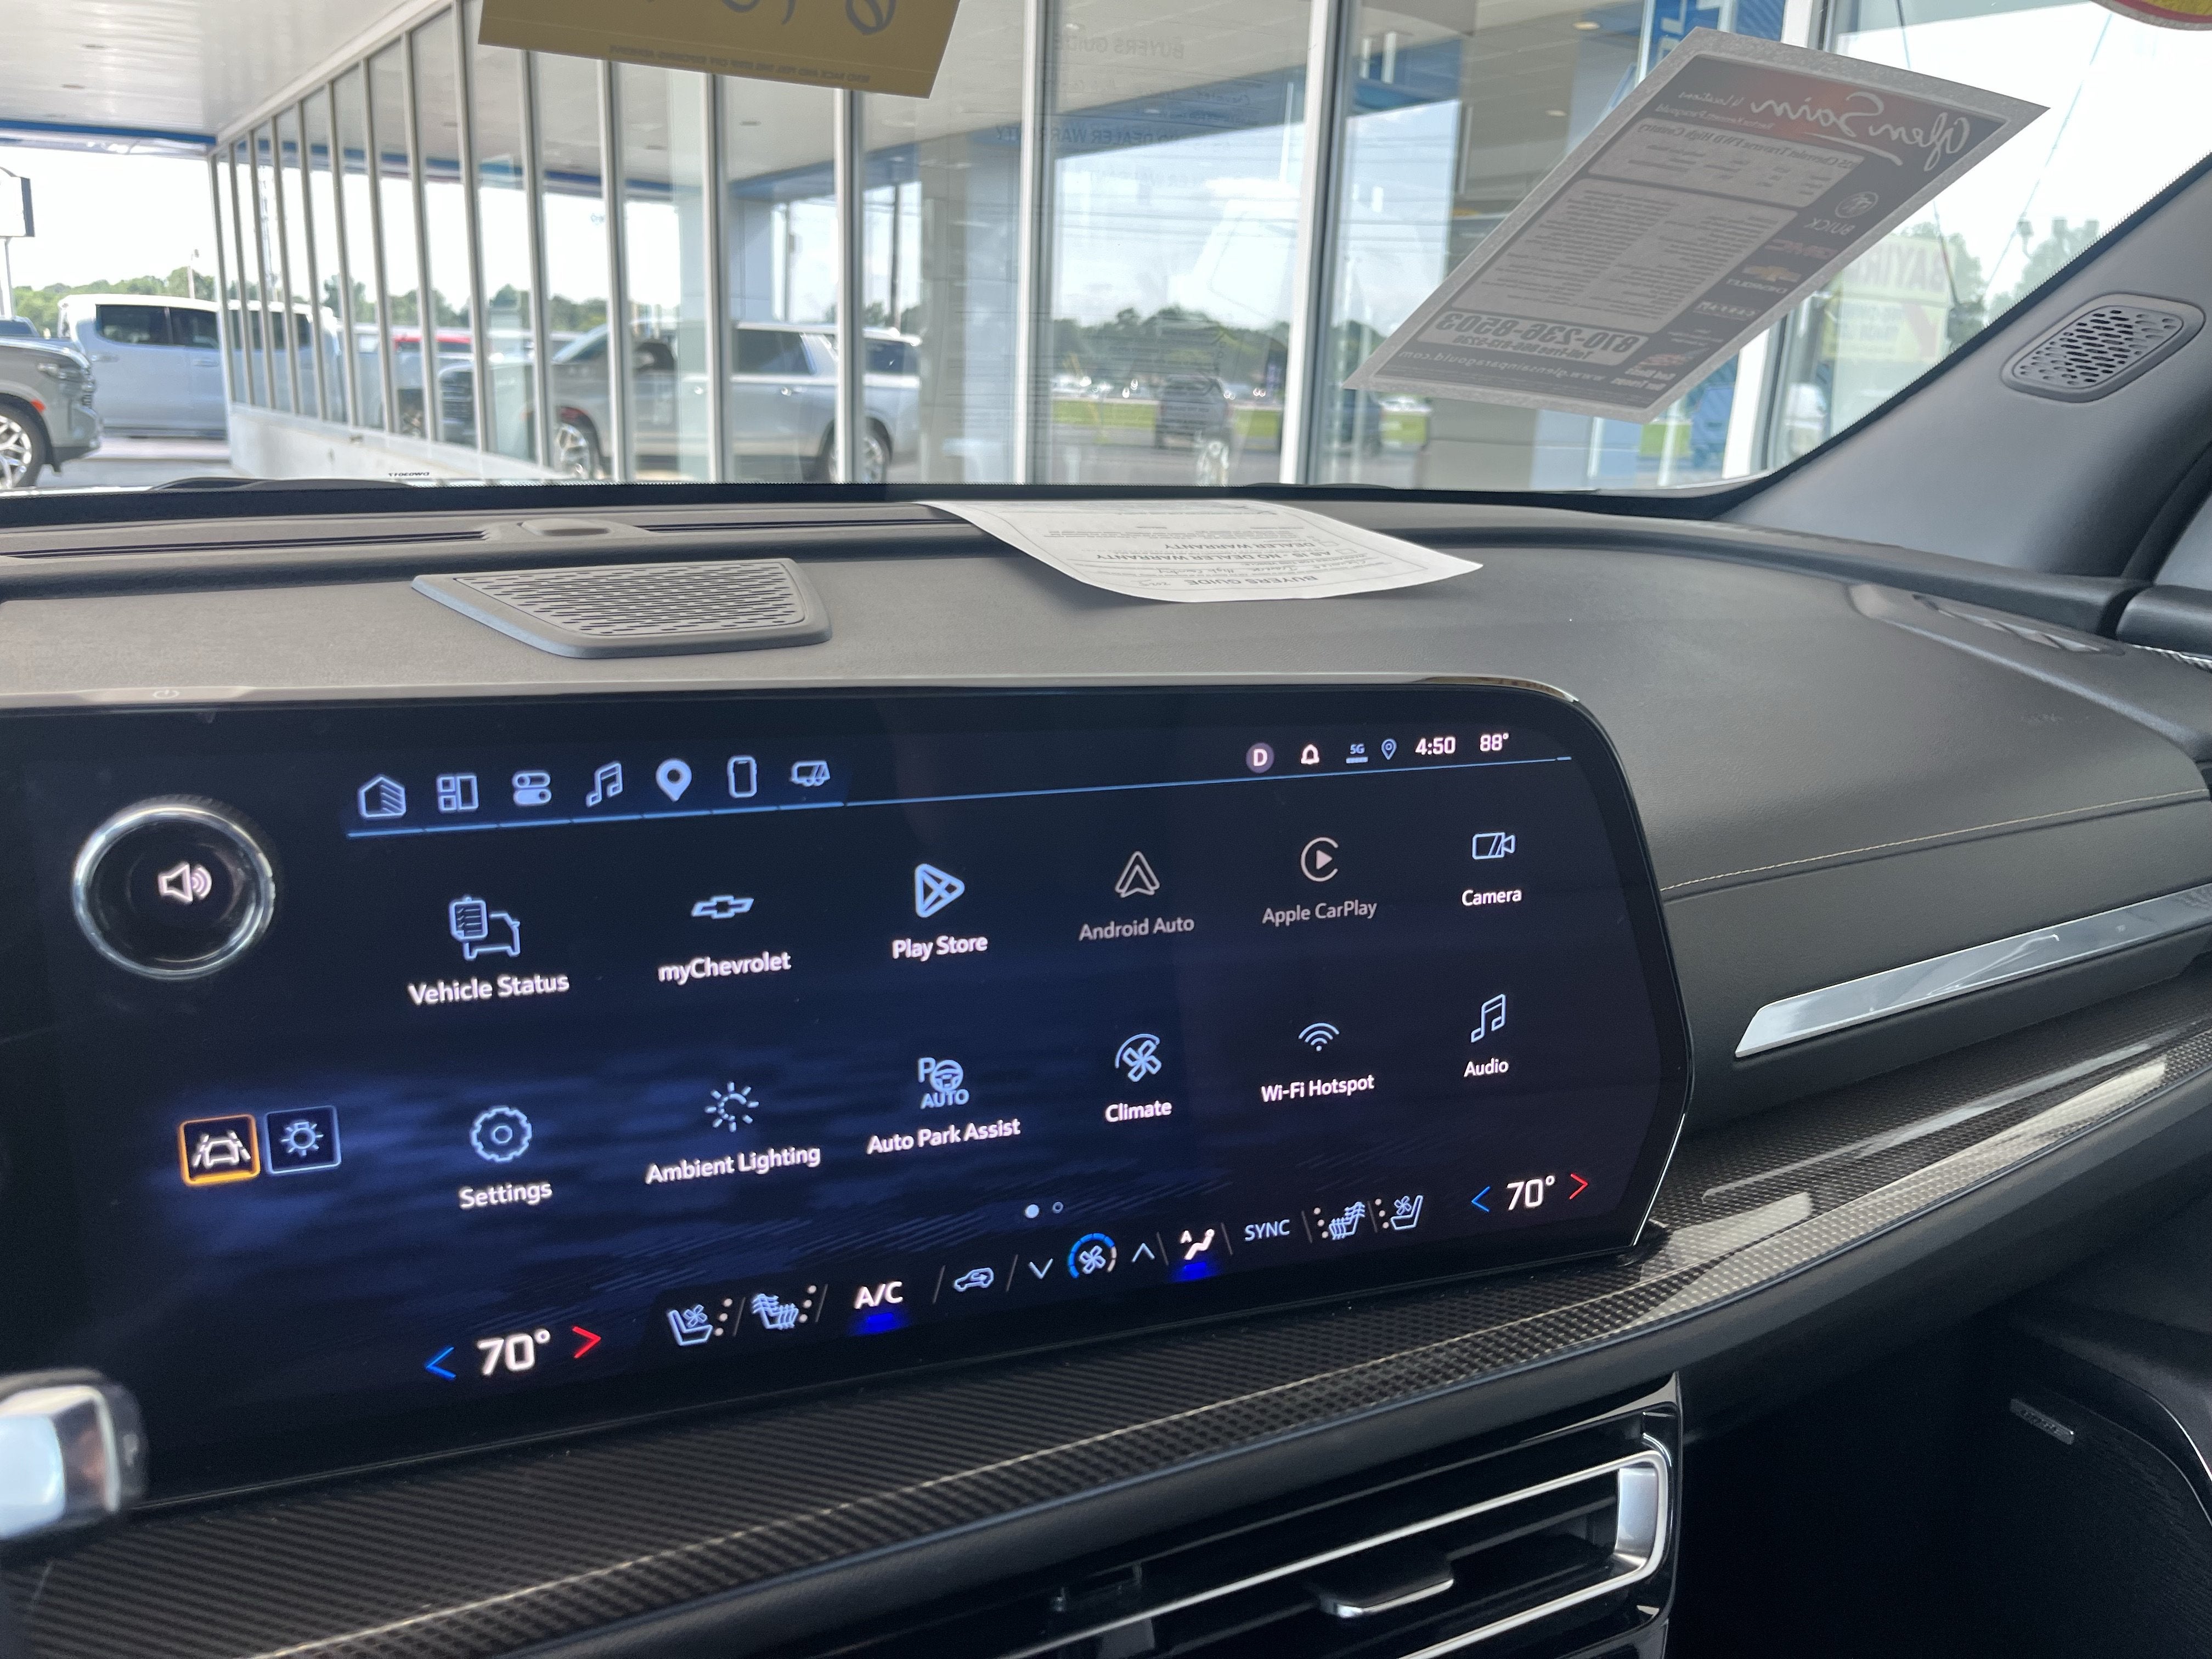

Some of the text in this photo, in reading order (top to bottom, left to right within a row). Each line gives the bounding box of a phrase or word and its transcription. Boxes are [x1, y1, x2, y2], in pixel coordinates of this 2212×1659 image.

[1245, 575, 1318, 584] BUYERS
[1254, 749, 1267, 766] D
[1350, 744, 1364, 754] 5G
[1415, 737, 1455, 755] 4:50
[1462, 890, 1521, 906] Camera
[1262, 900, 1377, 927] Apple CarPlay
[1079, 917, 1194, 940] Android Auto
[893, 935, 988, 961] Play Store
[658, 951, 791, 985] myChevrolet
[409, 975, 569, 1005] Vehicle Status
[1464, 1058, 1509, 1077] Audio
[921, 1086, 969, 1109] AUTO
[1261, 1075, 1374, 1102] Wi-Fi Hotspot
[1105, 1101, 1172, 1122] Climate
[867, 1119, 1020, 1154] Auto Park Assist
[646, 1147, 820, 1184] Ambient Lighting
[460, 1184, 552, 1208] Settings
[1245, 1220, 1290, 1241] SYNC
[855, 1282, 902, 1312] A/C
